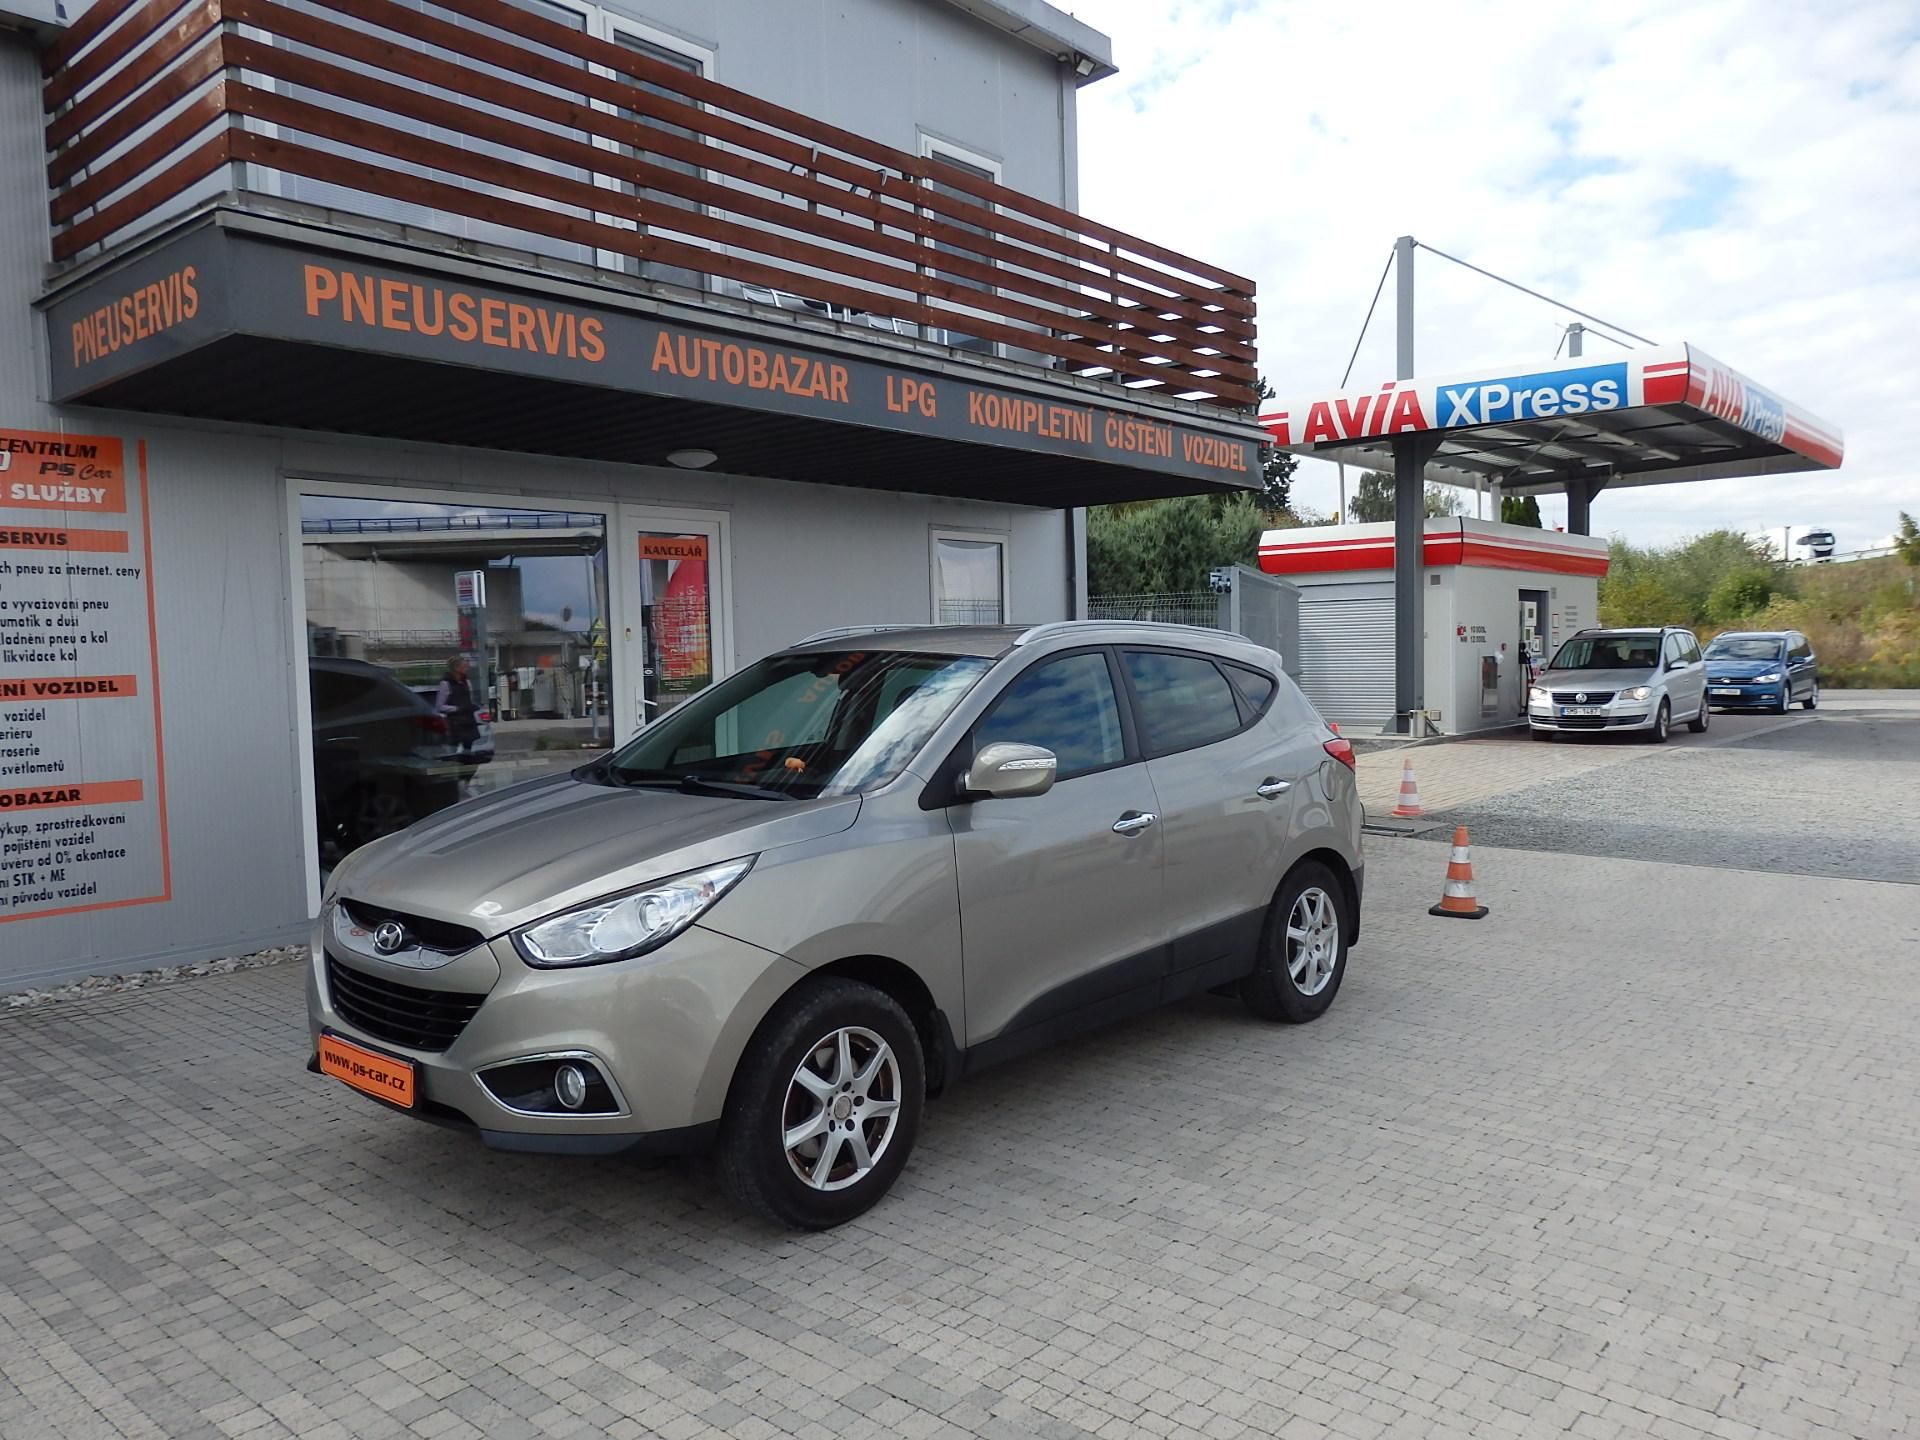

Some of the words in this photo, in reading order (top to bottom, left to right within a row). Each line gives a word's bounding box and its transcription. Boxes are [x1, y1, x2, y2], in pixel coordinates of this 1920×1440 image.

[73, 266, 199, 368] PNEUSERVIS
[305, 264, 606, 362] PNEUSERVIS
[651, 331, 849, 403] AUTOBAZAR
[886, 376, 936, 417] LPG
[968, 391, 1093, 444] KOMPLETNÍ
[1104, 410, 1173, 458] ČIŠTĚNÍ
[1183, 433, 1247, 472] VOZIDEL
[1445, 379, 1619, 427] XPress
[40, 462, 76, 476] PS
[79, 464, 112, 480] Car
[11, 483, 106, 504] SLUŽBY
[0, 531, 67, 546] SERVIS
[16, 565, 44, 577] pneu
[48, 566, 61, 575] za
[116, 567, 141, 579] ceny
[82, 601, 109, 613] pneu
[45, 618, 52, 627] a
[49, 635, 76, 647] pneu
[80, 635, 87, 644] a
[91, 630, 108, 644] kol
[3, 649, 56, 663] likvidace
[60, 647, 78, 662] kol
[0, 680, 26, 696] NÍ
[33, 680, 118, 695] VOZIDEL
[4, 708, 46, 721] vozidel
[0, 789, 81, 807] OBAZAR
[55, 831, 94, 847] vozidel
[38, 852, 51, 867] od
[55, 850, 72, 865] 0%
[76, 848, 126, 863] akontace
[13, 872, 36, 887] STK
[50, 868, 66, 883] ME
[57, 881, 97, 899] vozidel
[325, 1050, 406, 1091] www.ps-car.cz
